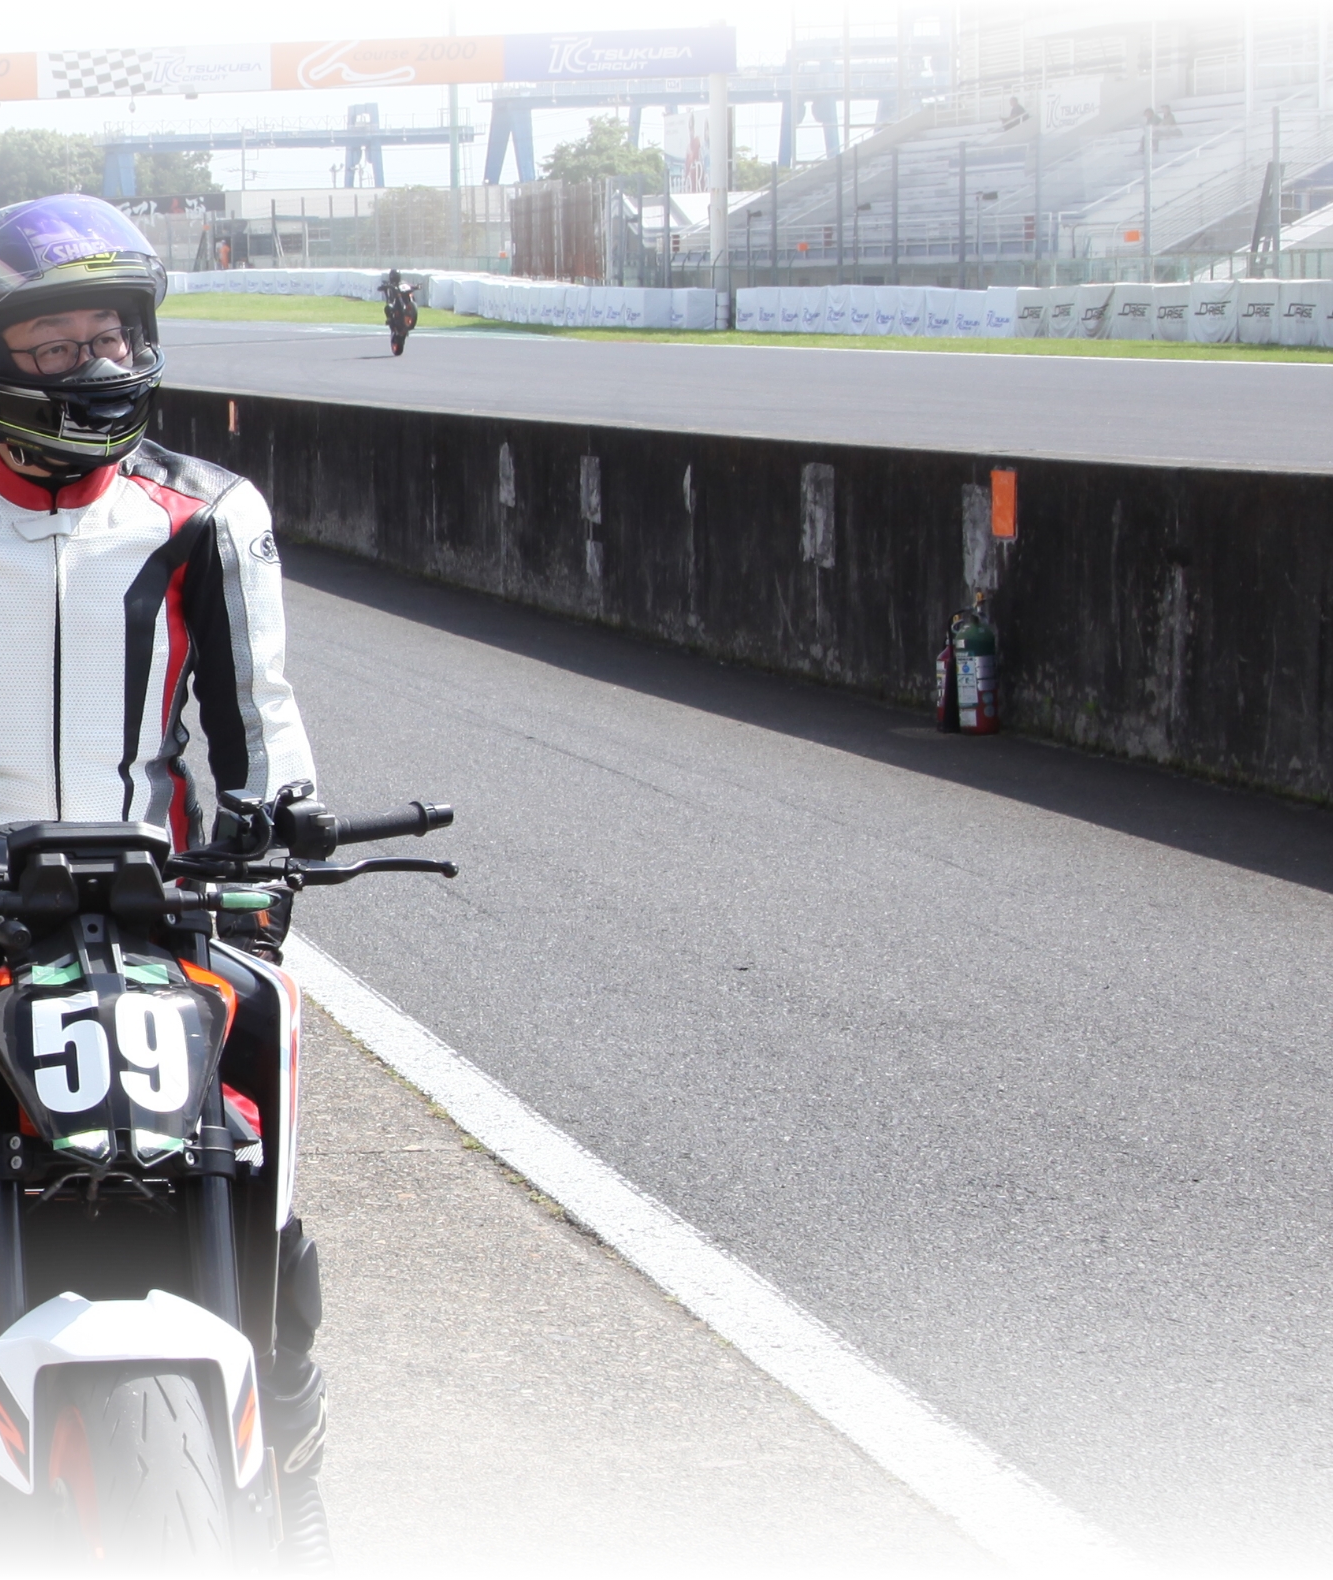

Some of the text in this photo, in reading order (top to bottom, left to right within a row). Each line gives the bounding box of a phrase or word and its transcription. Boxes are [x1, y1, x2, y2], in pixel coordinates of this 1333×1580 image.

[353, 42, 477, 61] course 2000
[591, 46, 693, 61] TSUKUBA
[186, 62, 263, 74] TSUKUBA
[31, 990, 192, 1113] 59
